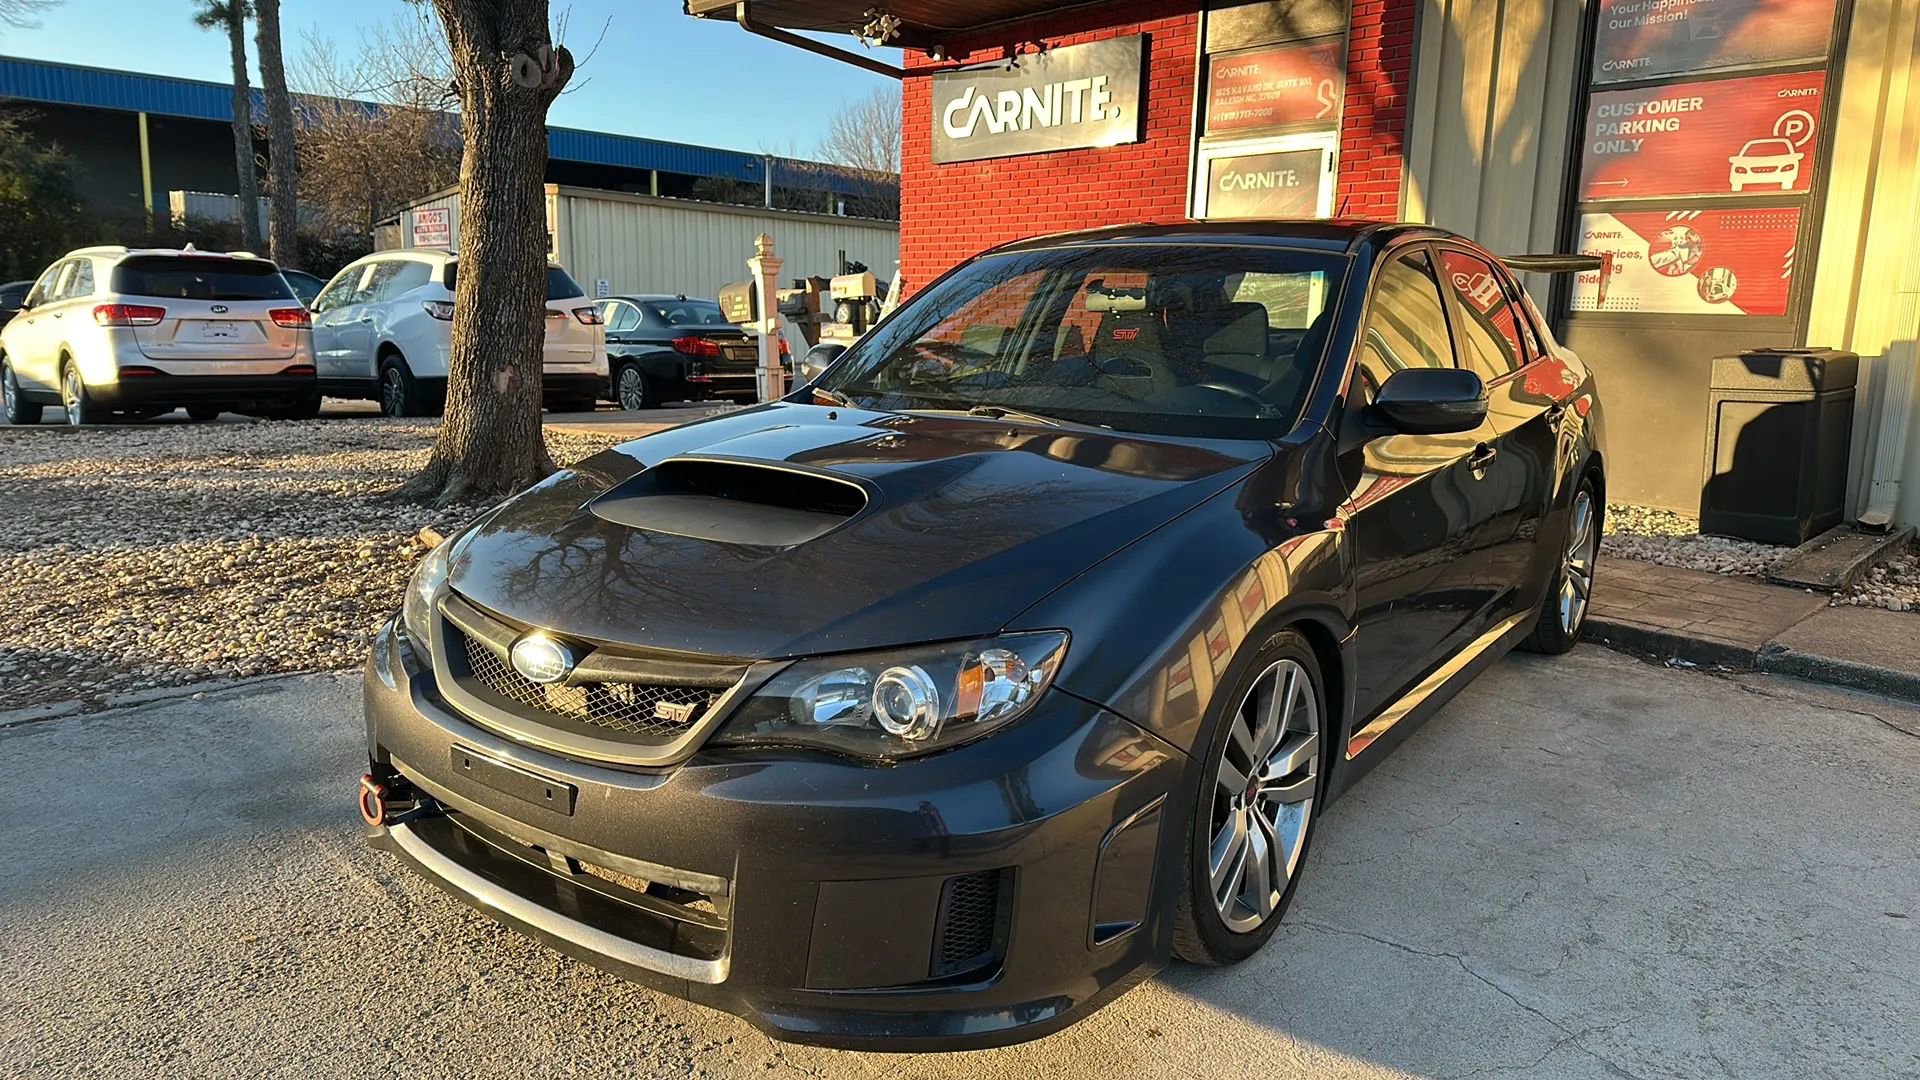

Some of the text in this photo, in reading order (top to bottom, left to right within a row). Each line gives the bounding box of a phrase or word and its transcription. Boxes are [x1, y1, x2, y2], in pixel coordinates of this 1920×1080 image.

[1611, 4, 1640, 16] Your
[1609, 9, 1688, 30] Our Mission!
[1276, 79, 1297, 89] SUITE
[943, 75, 1121, 139] CARNITE.
[1597, 96, 1704, 118] CUSTOMER
[1595, 117, 1680, 136] PARKING
[1785, 120, 1804, 137] P
[1593, 138, 1644, 154] ONLY
